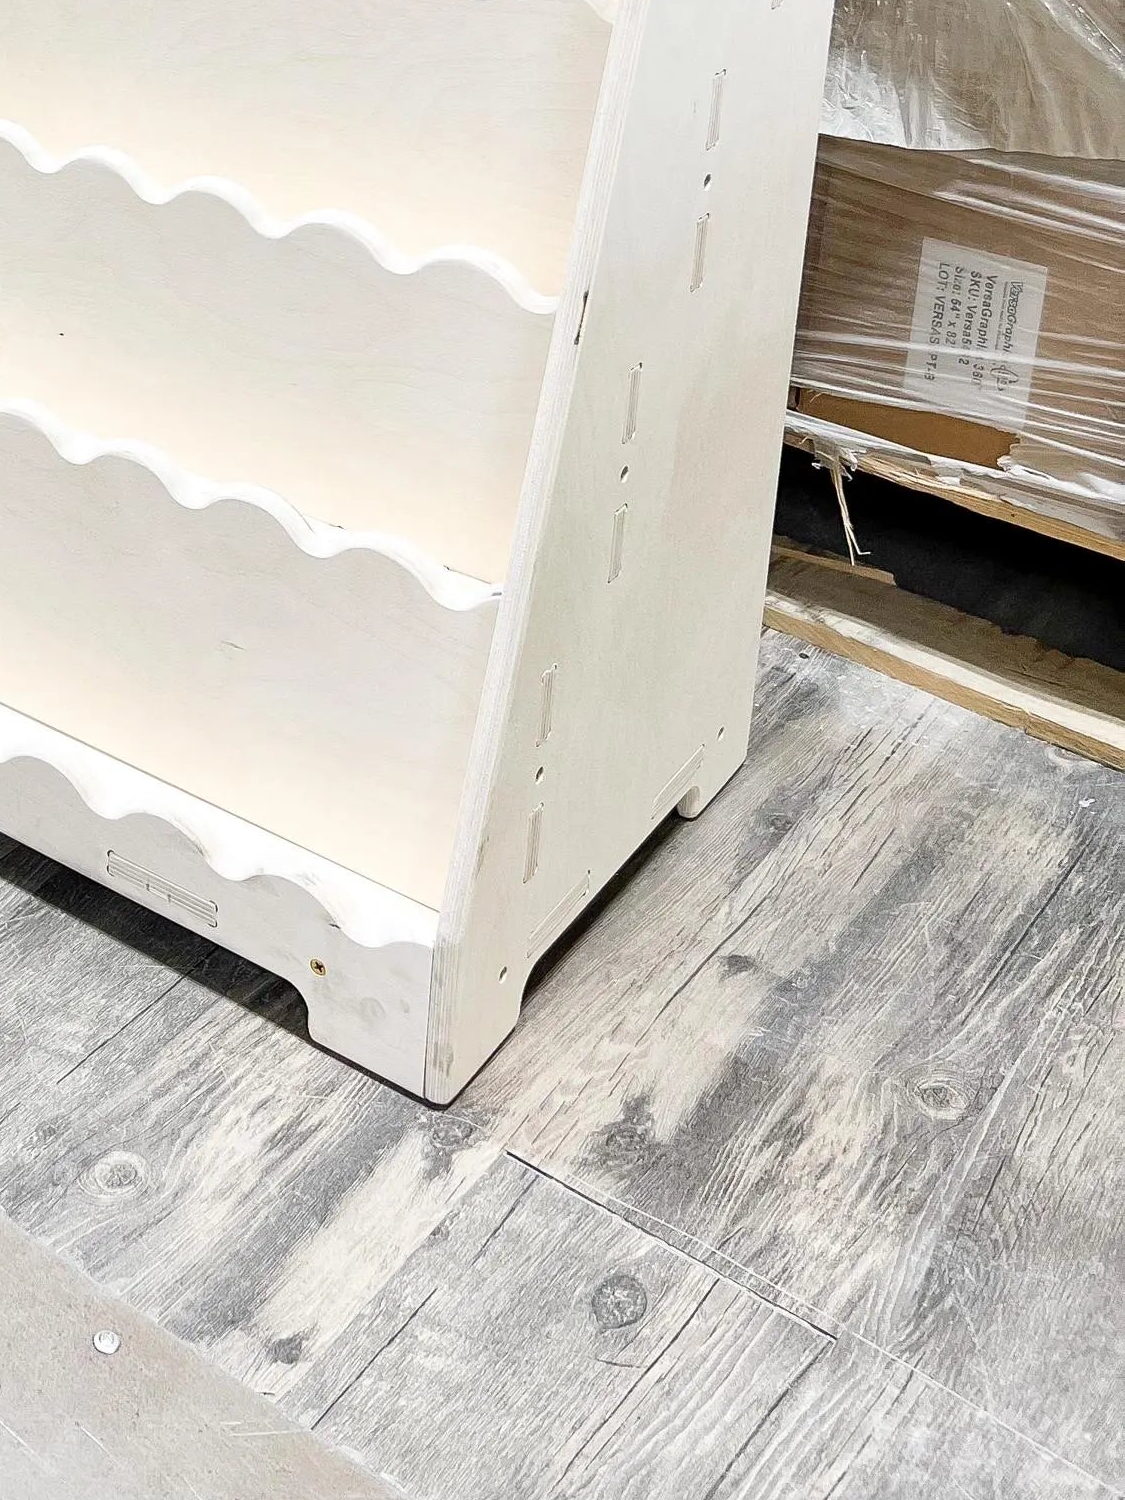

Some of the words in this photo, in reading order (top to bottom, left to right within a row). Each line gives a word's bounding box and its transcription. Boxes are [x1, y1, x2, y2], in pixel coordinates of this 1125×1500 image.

[939, 263, 951, 294] LOT:
[968, 271, 982, 301] SKU:
[976, 275, 998, 350] VersaGraphi
